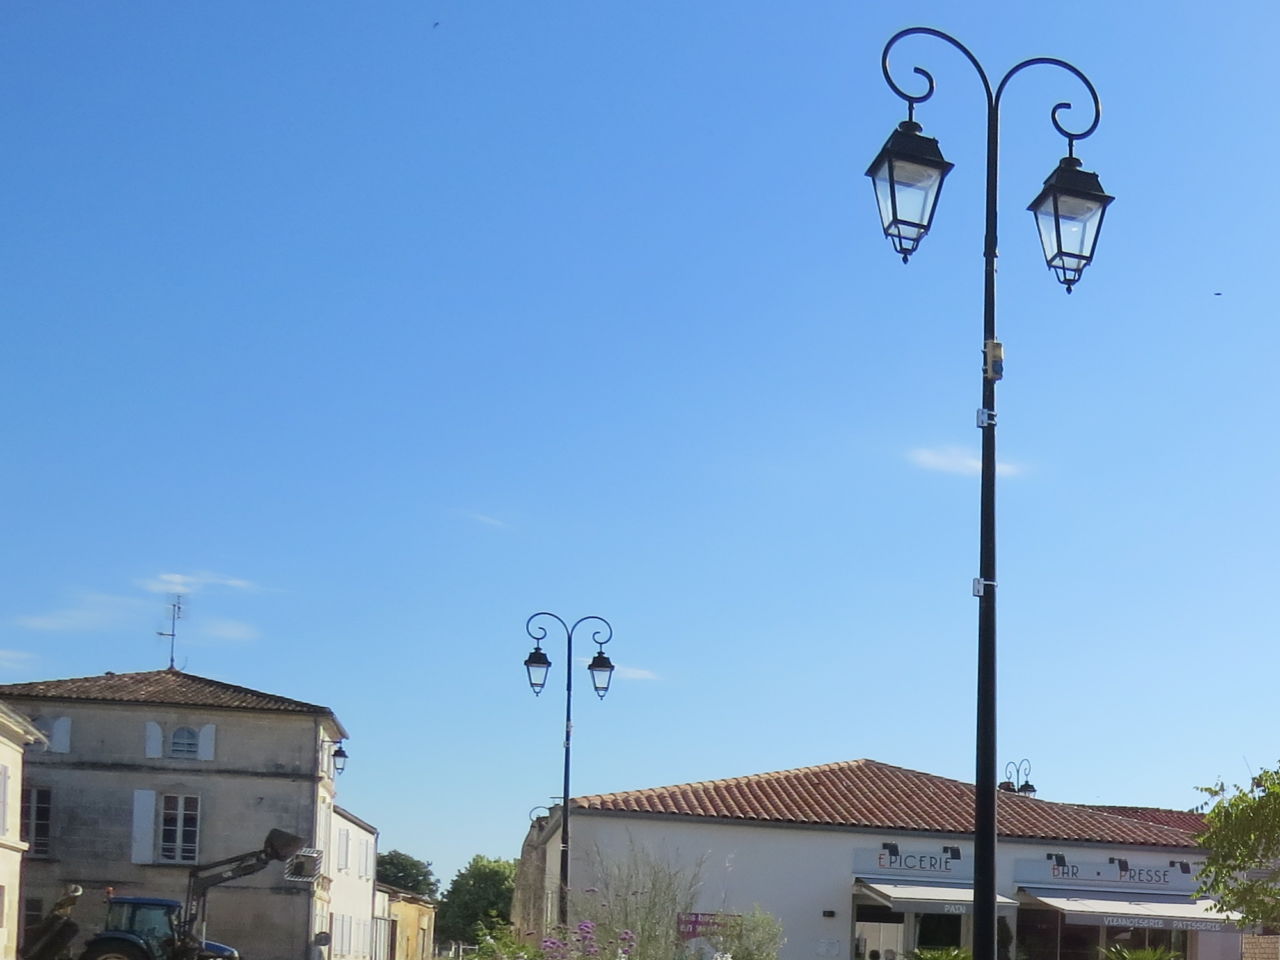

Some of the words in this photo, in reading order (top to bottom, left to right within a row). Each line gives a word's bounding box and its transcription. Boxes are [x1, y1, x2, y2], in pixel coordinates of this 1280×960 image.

[1052, 864, 1079, 879] BAR
[1119, 868, 1169, 883] PRESSE
[944, 904, 967, 914] PAIN
[1103, 916, 1164, 928] VIENNOISERIE
[1172, 920, 1221, 931] PATISSERIE
